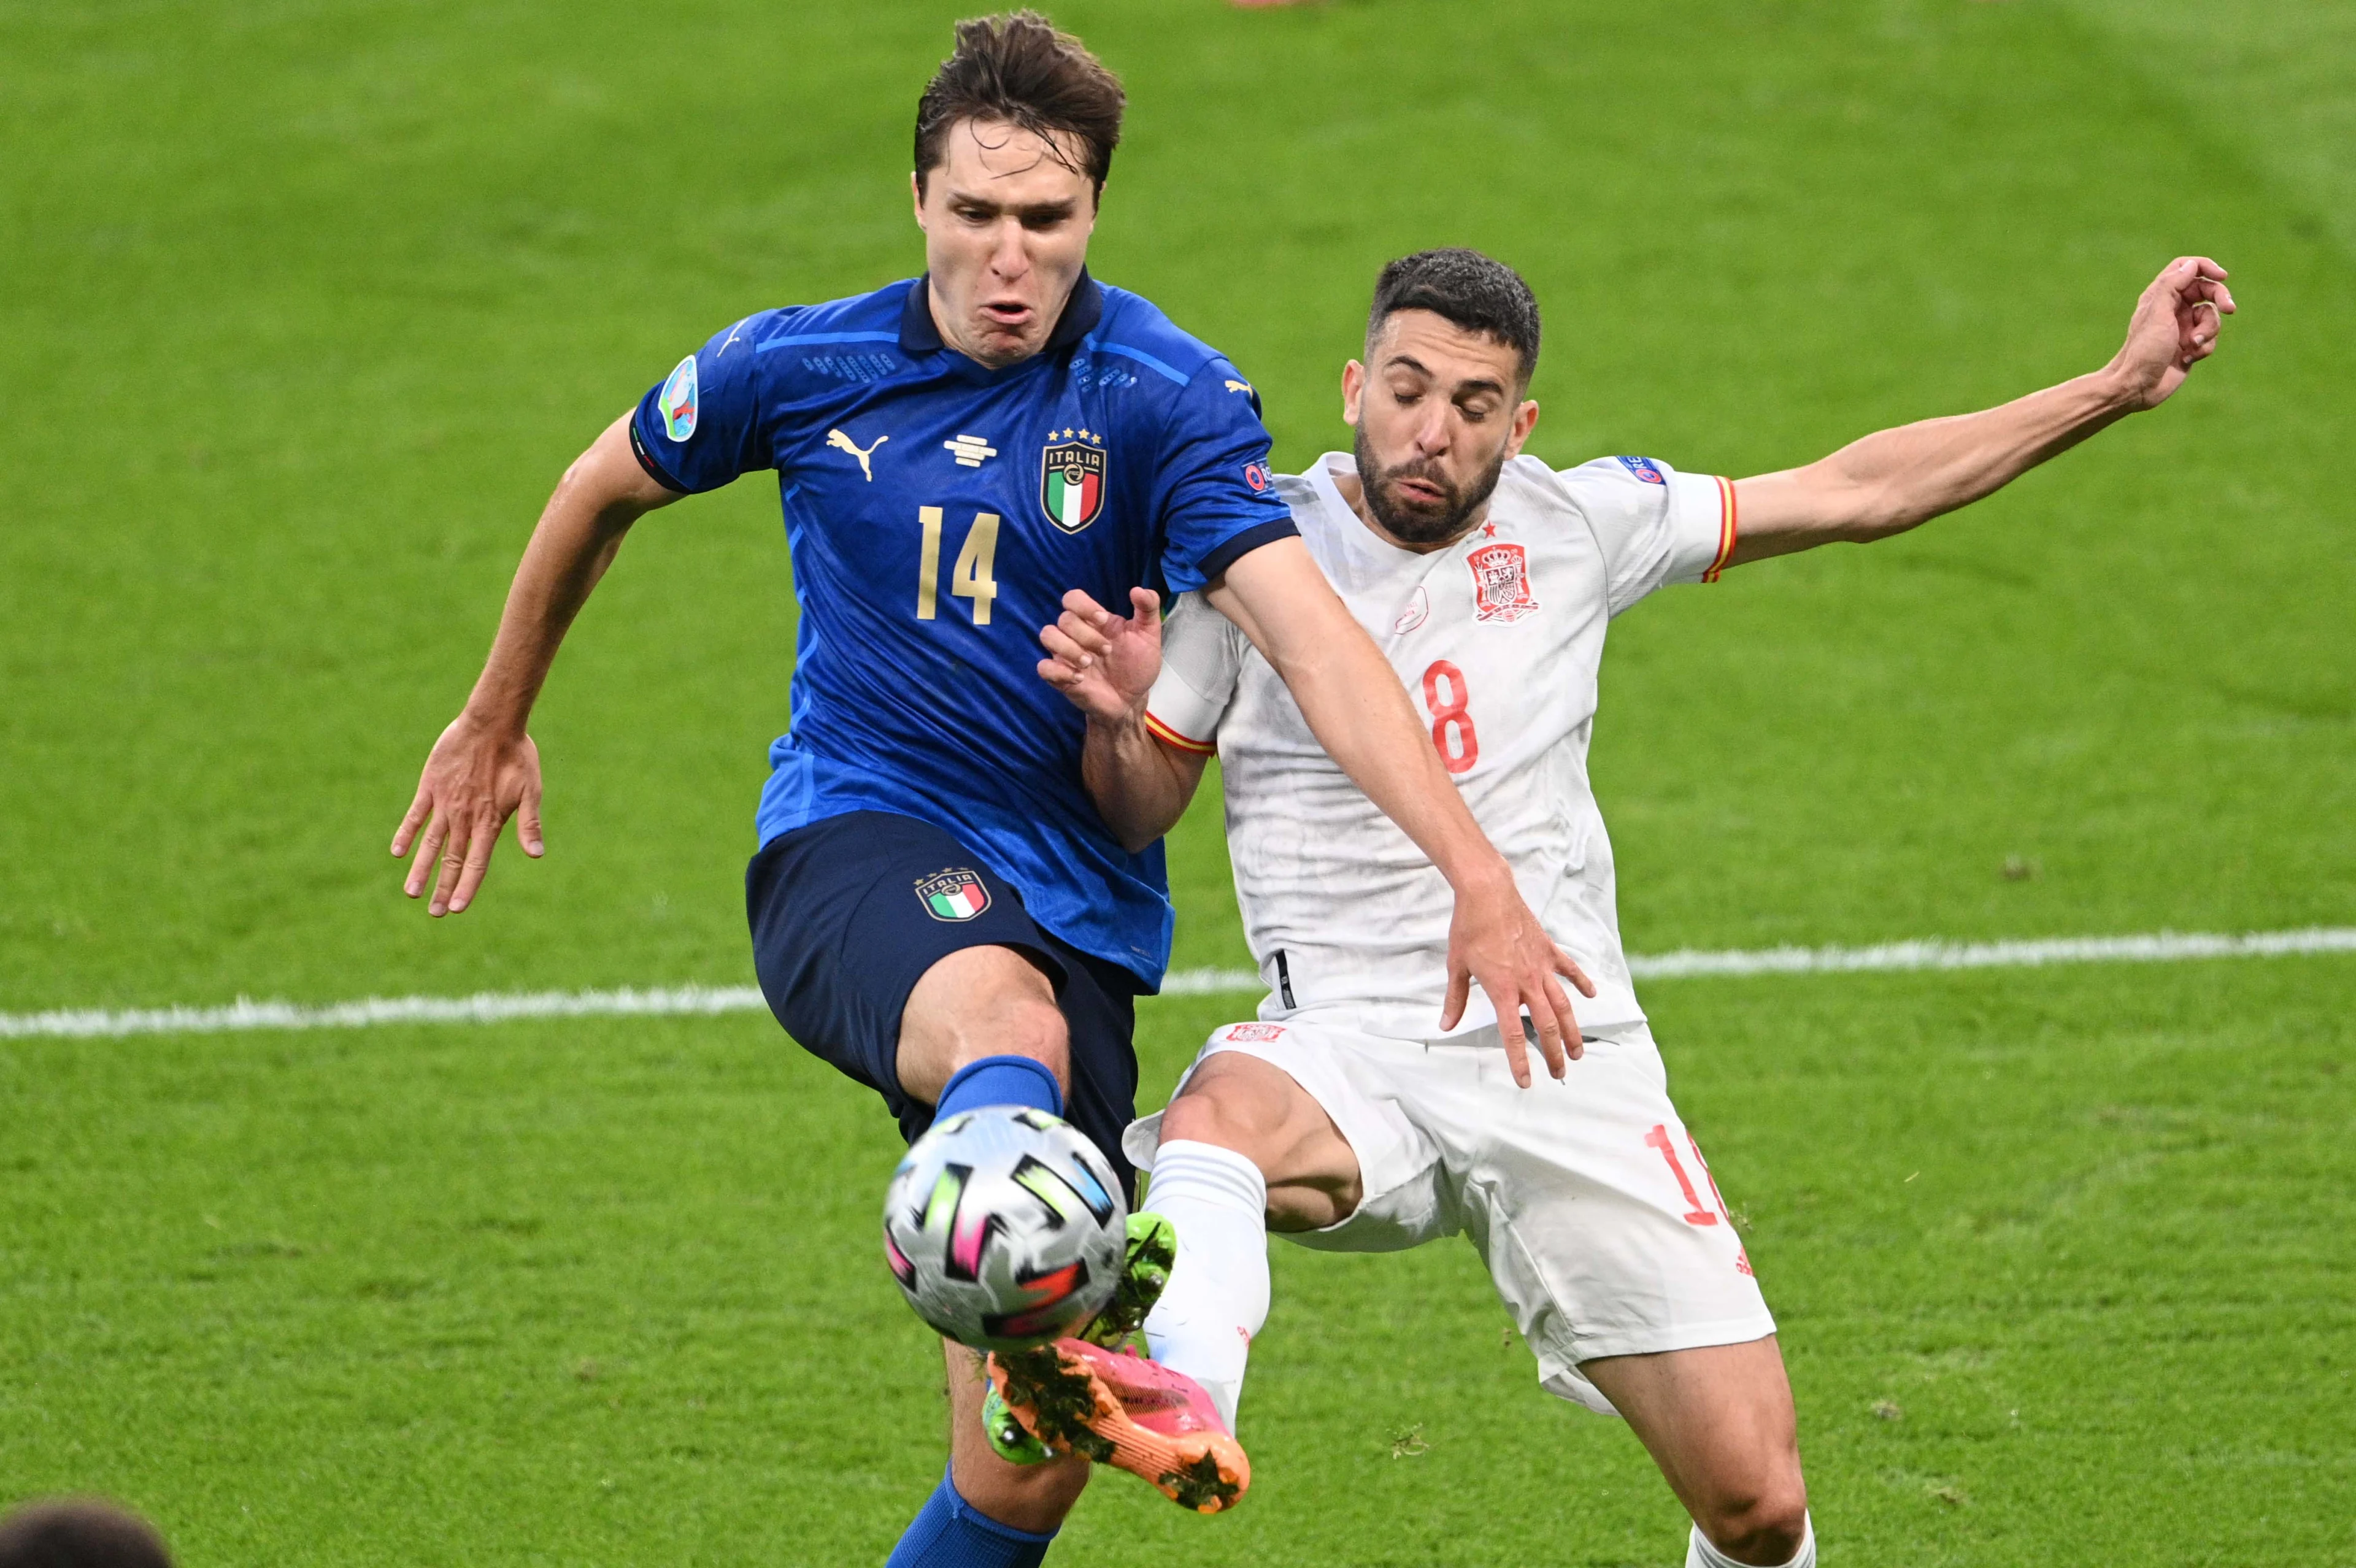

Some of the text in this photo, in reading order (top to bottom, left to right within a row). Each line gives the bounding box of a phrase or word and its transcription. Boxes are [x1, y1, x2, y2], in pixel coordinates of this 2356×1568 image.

[1049, 451, 1099, 466] ITALIA
[917, 505, 1001, 625] 14
[923, 874, 972, 894] ITALIA
[1644, 1124, 1731, 1226] 1
